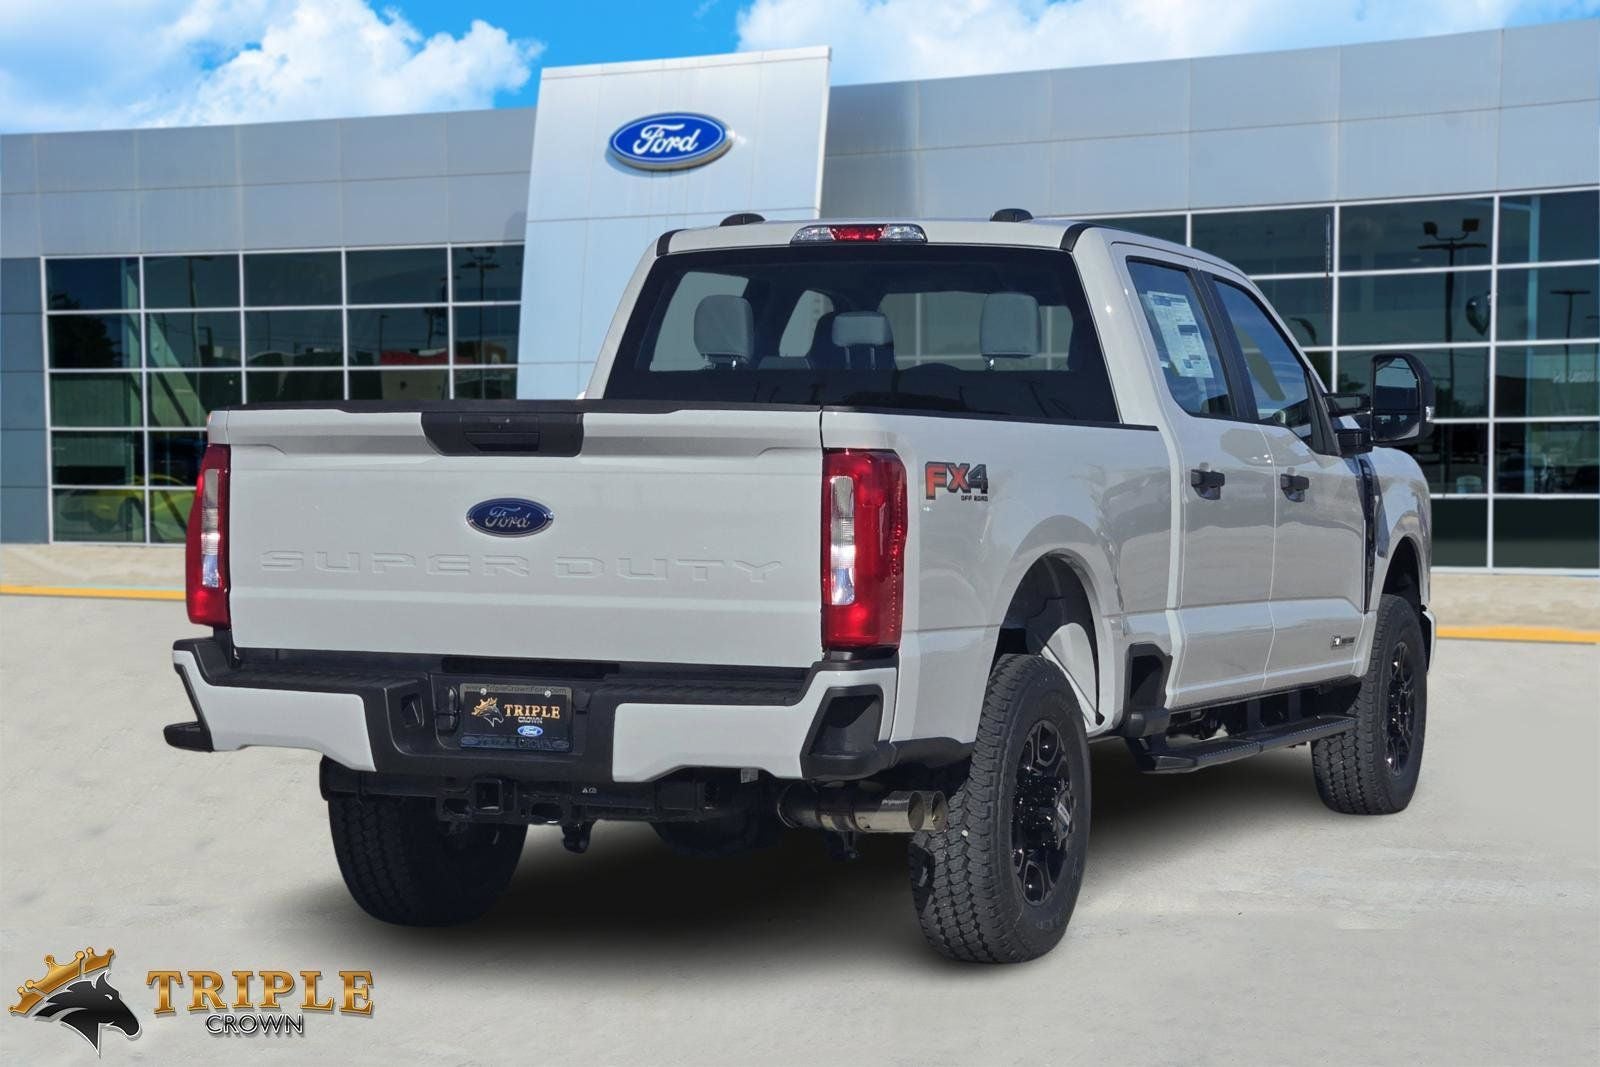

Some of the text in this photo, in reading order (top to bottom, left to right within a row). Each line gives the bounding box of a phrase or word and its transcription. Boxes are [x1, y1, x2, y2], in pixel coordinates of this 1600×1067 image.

[633, 123, 702, 155] Ford
[924, 461, 989, 500] FX4
[485, 506, 532, 528] Ford
[259, 550, 783, 584] SUPER DUTY
[503, 703, 561, 719] TRIPLE
[517, 716, 543, 724] CROWN
